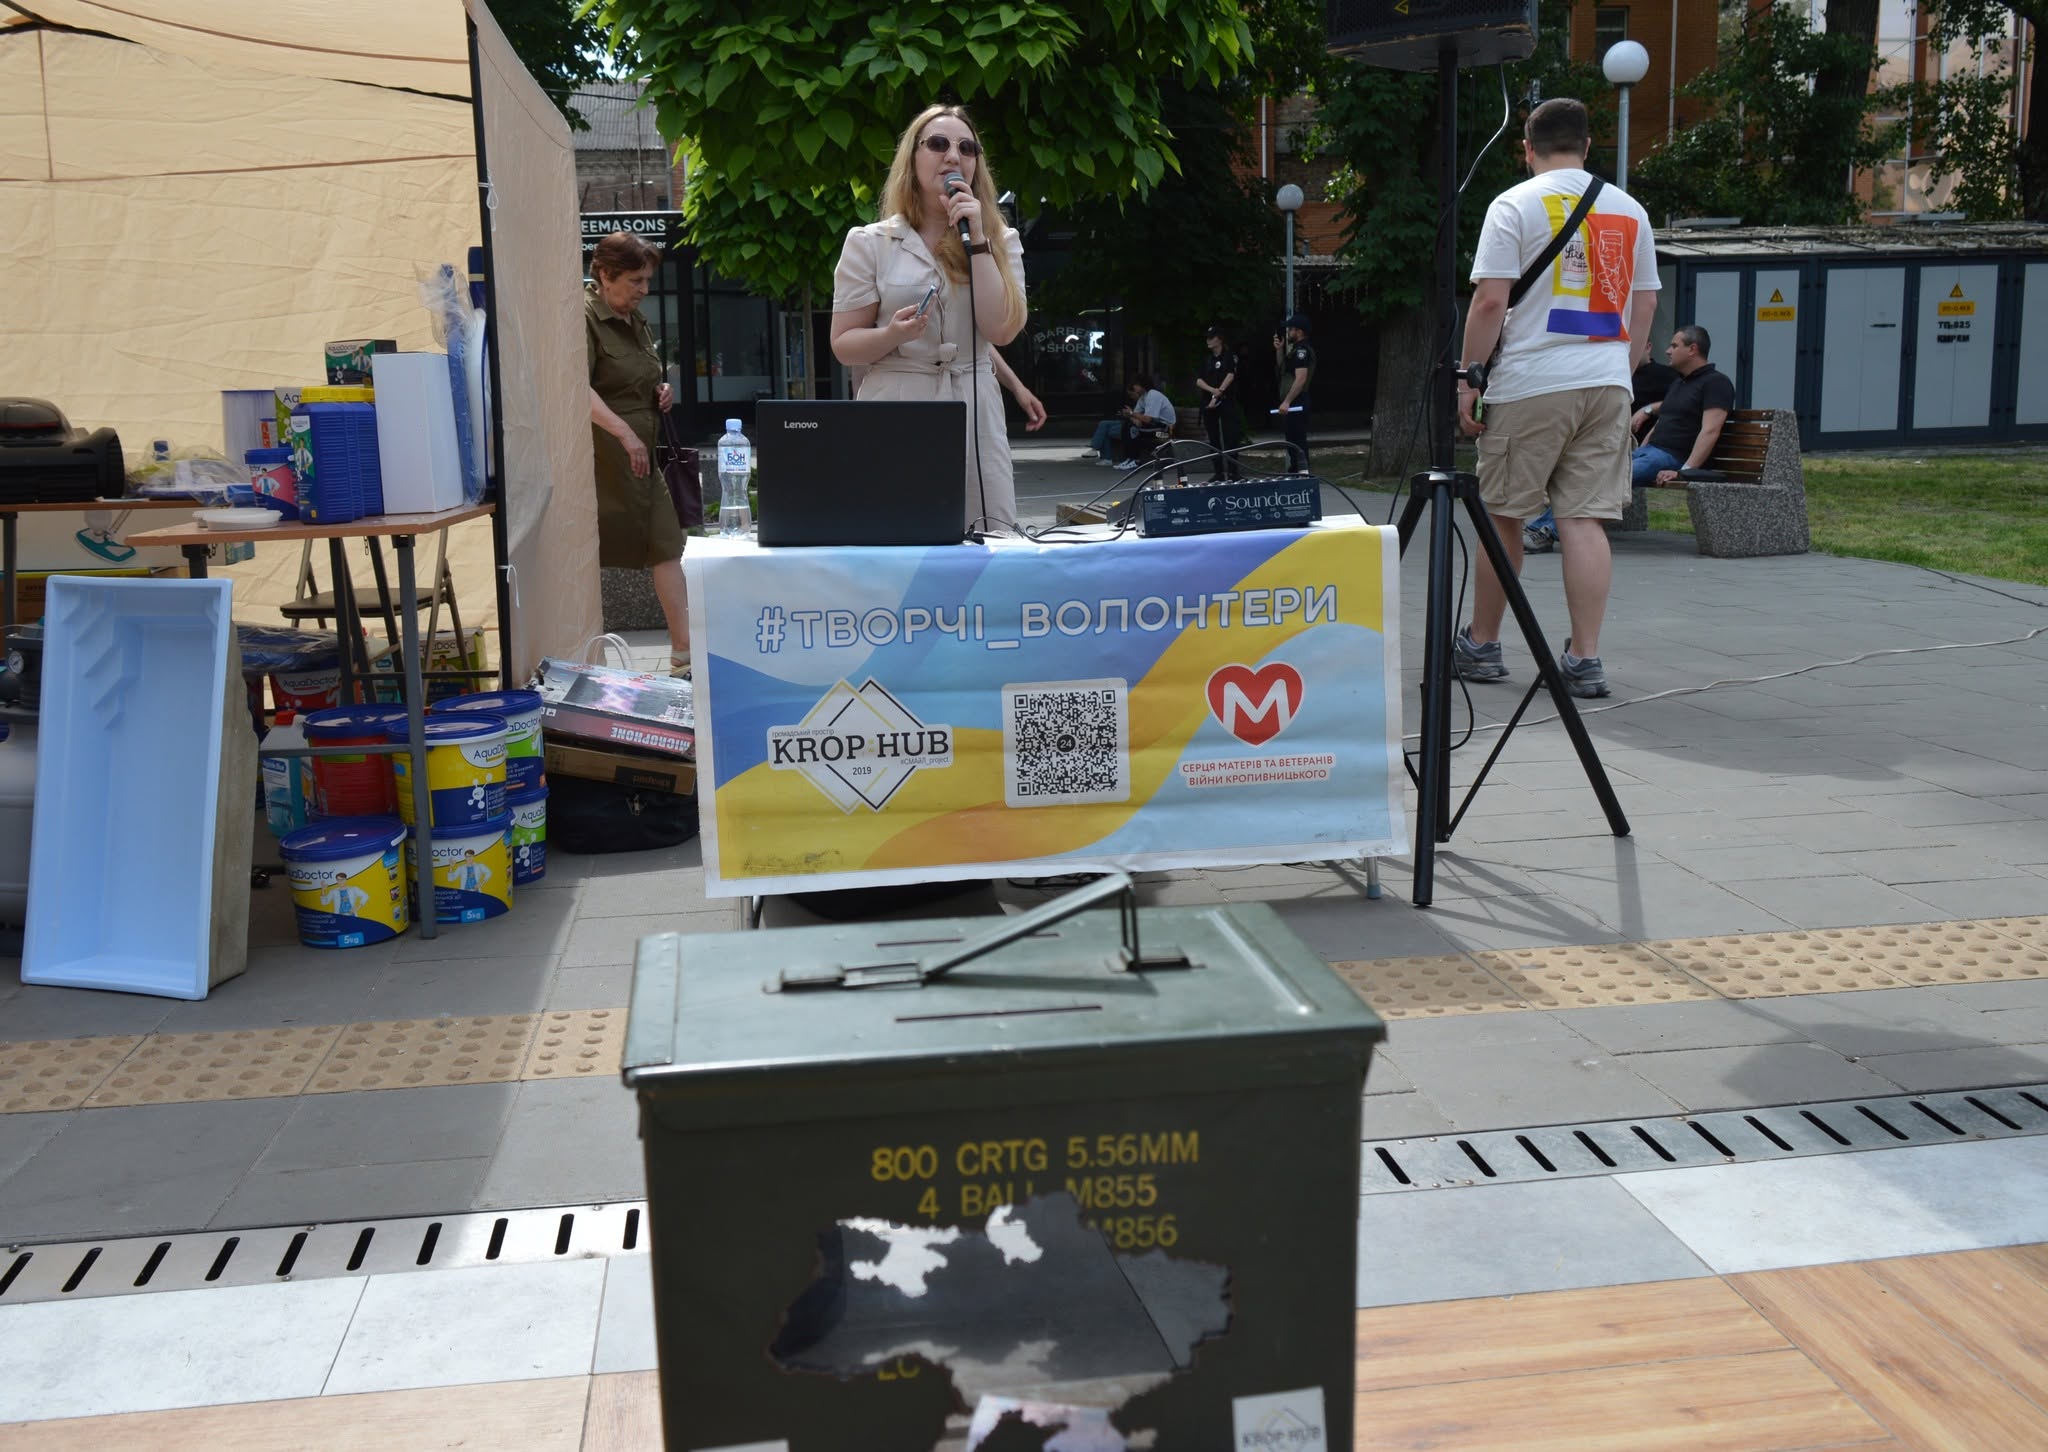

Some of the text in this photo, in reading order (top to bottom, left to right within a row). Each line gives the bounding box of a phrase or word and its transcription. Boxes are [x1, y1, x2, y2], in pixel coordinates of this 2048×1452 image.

[1046, 343, 1085, 353] SHOP
[784, 420, 819, 429] Lenovo
[727, 452, 746, 462] БОН
[1225, 491, 1311, 511] Soundcraft
[756, 584, 1337, 654] #ТВОРЧІ_ВОЛОНТЕРИ
[610, 726, 690, 751] MICROPHONE
[1060, 739, 1073, 749] 24
[852, 766, 872, 776] 2019
[1182, 756, 1333, 773] СЕРЦЯ МАТЕРІВ ТА ВЕТЕРАНІВ
[1189, 769, 1327, 786] ВІЙНИ КРОПИВНИЦЬКОГО
[871, 1131, 1200, 1182] 800 CRTG 5.56MM
[917, 1187, 941, 1220] 4
